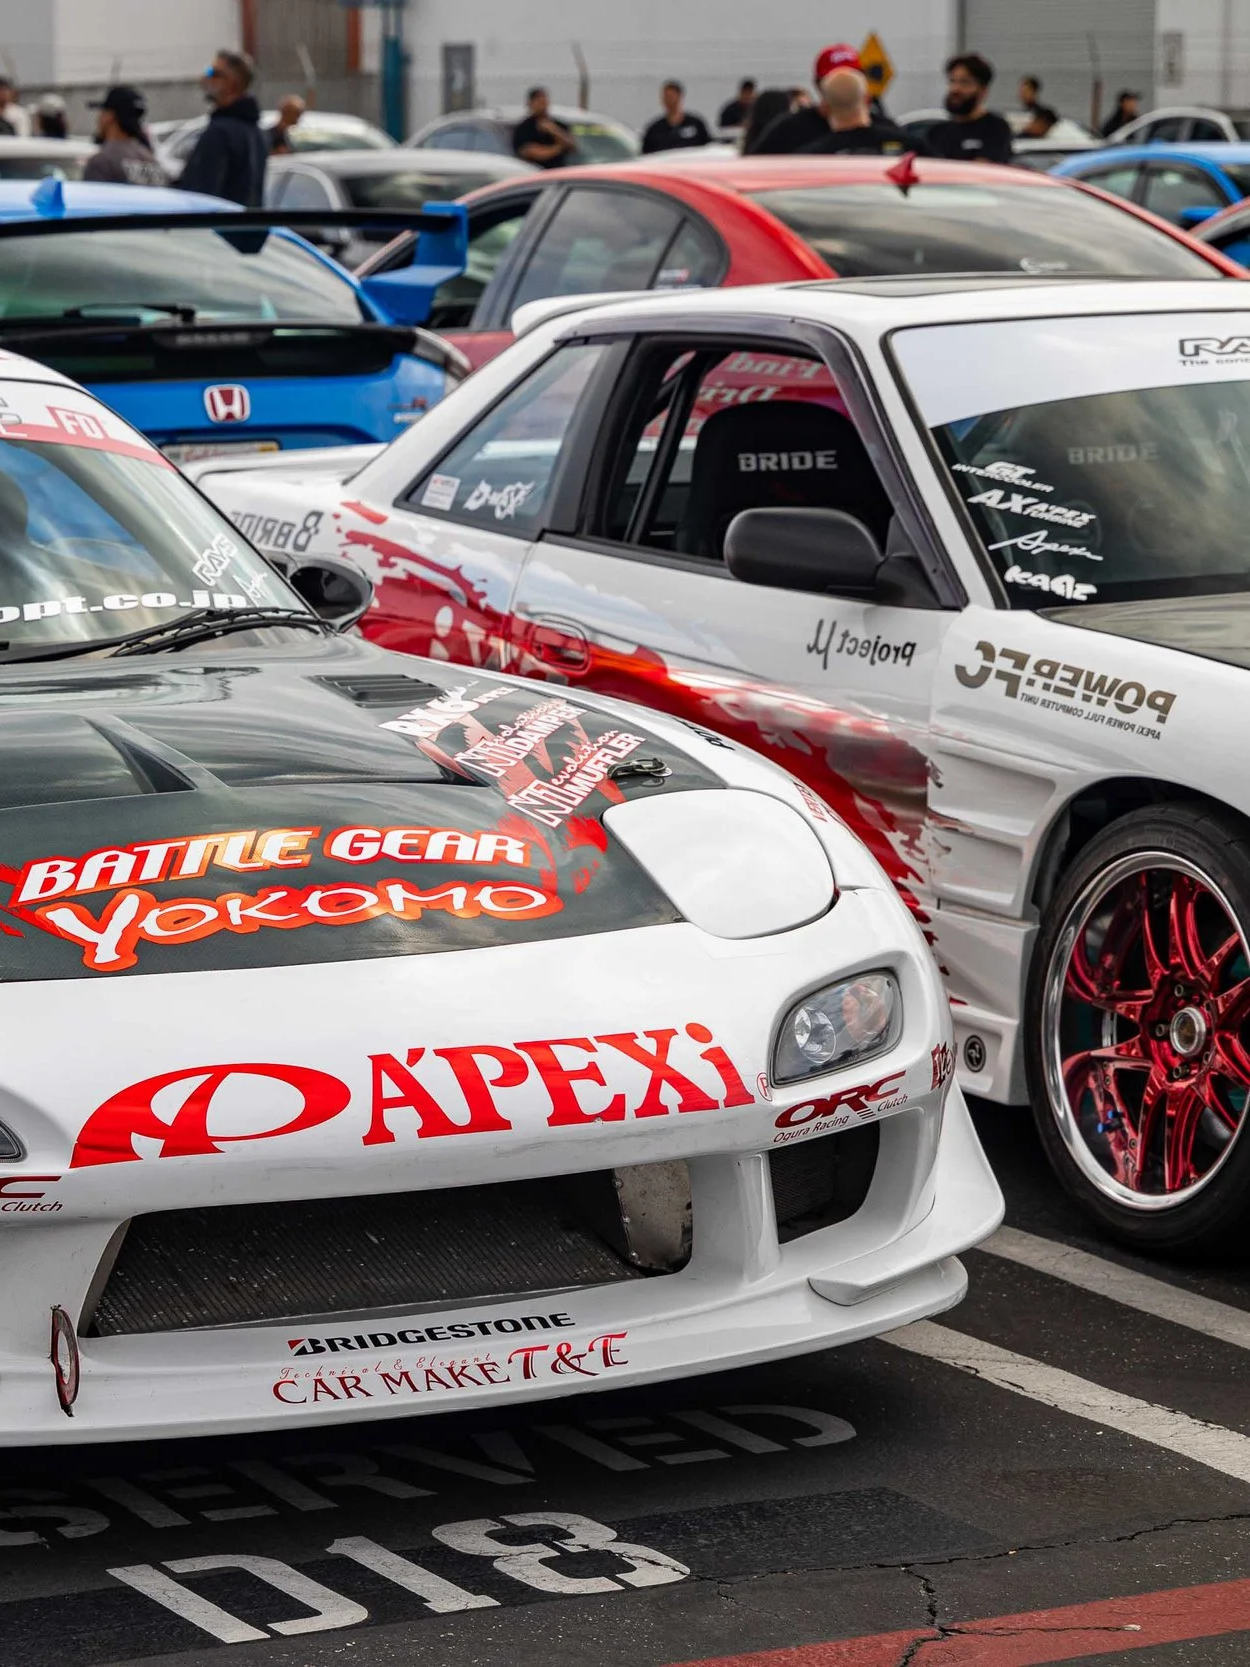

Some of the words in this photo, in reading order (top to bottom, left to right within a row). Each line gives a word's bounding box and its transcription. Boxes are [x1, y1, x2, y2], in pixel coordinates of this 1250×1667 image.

[54, 408, 105, 440] FD
[737, 450, 839, 473] BRIDE
[1067, 442, 1160, 465] BRIDE
[510, 703, 589, 760] DAMPER
[550, 727, 620, 787] evolution
[567, 731, 647, 808] MUFFLER
[16, 826, 318, 904] BATTLE
[329, 827, 532, 867] GEAR
[44, 881, 549, 966] YOKOMO
[773, 1126, 811, 1144] Ogura
[812, 1113, 850, 1133] Racing
[877, 1092, 909, 1113] Clutch
[774, 1069, 907, 1130] ORC
[0, 1200, 63, 1213] Clutch
[286, 1312, 577, 1357] BRIDGESTONE
[271, 1374, 374, 1405] CAR
[377, 1361, 511, 1396] MAKE
[279, 1360, 383, 1380] Technical
[415, 1352, 492, 1369] Elegant
[105, 1510, 693, 1645] D18
